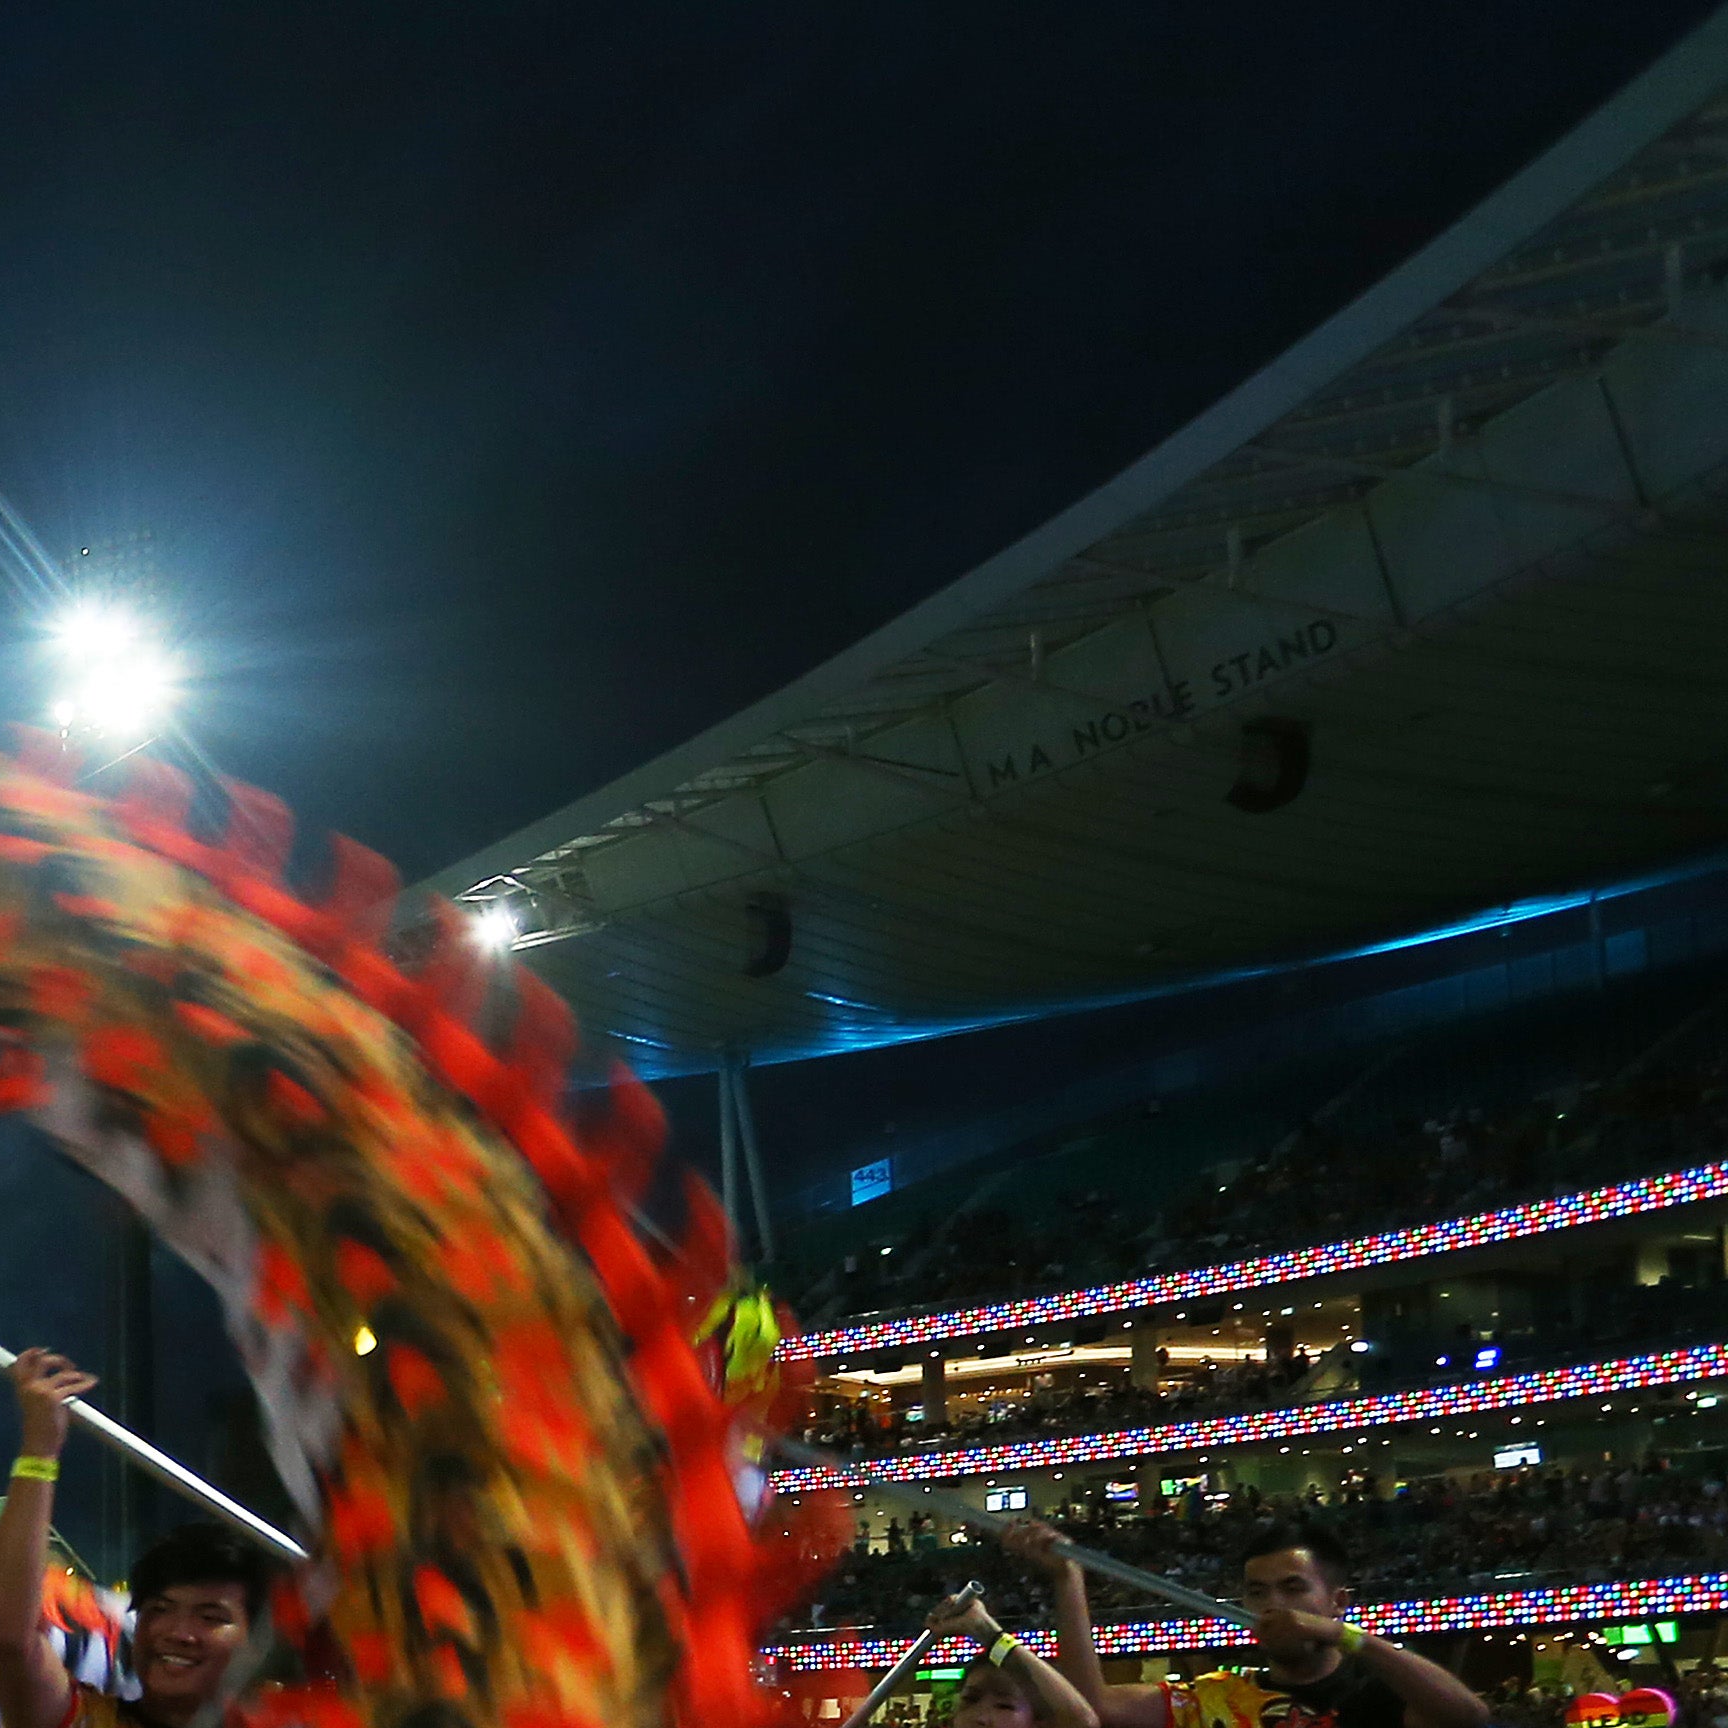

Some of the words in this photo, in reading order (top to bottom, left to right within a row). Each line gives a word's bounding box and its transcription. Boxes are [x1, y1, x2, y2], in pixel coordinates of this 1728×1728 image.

[987, 754, 1019, 788] M
[1030, 743, 1052, 773] A
[1072, 679, 1197, 755] NOBLE
[1211, 618, 1338, 698] STAND
